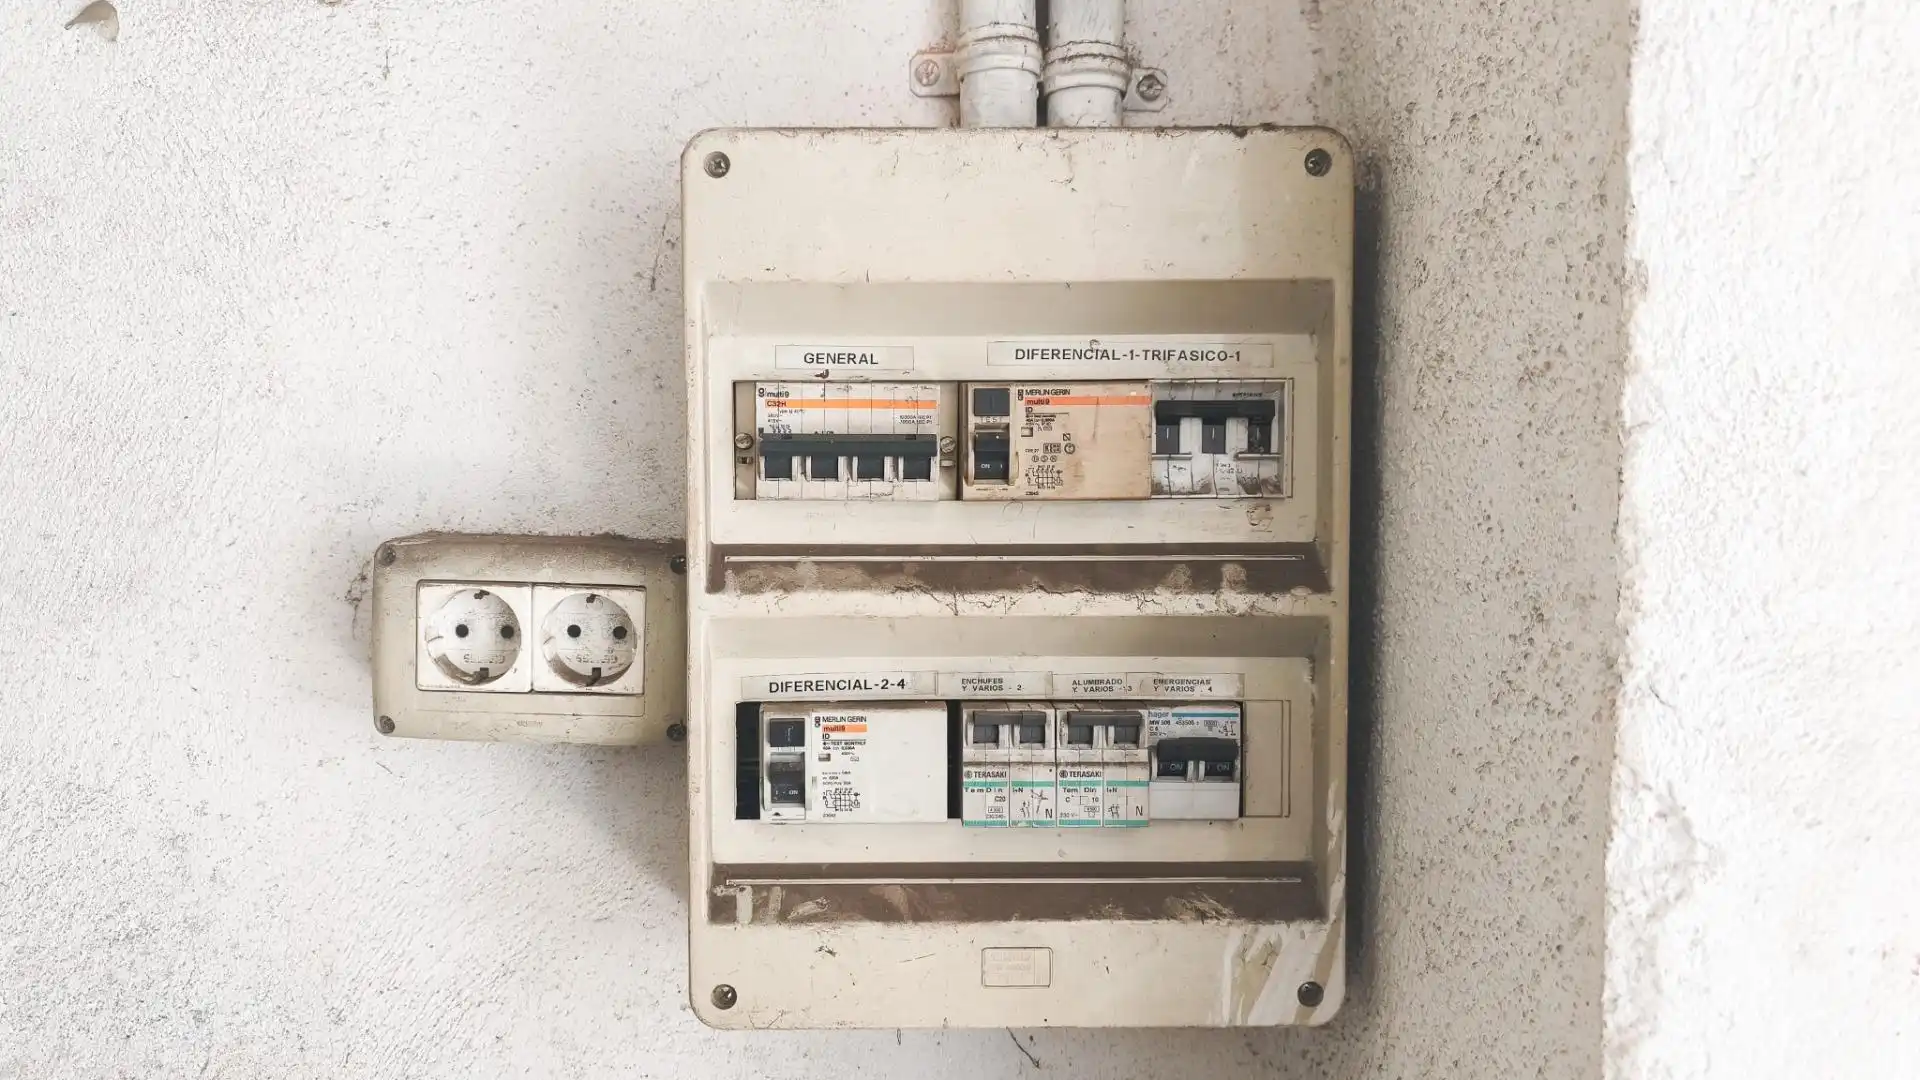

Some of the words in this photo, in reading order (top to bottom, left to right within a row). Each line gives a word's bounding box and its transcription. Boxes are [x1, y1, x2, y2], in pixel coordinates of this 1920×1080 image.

[803, 352, 879, 365] GENERAL
[1014, 347, 1242, 362] DIFERENCIAL-1-TRIFASICO-1
[1025, 388, 1050, 396] MERLIN
[1050, 388, 1071, 396] GERIN
[961, 676, 1004, 685] ENCHUFES
[1071, 678, 1123, 686] ALUMBRADO
[1153, 678, 1212, 686] EMERGENCIAS
[768, 678, 907, 693] DIFERENCIAL-2-4
[961, 684, 968, 692] Y
[972, 684, 1004, 692] VARIOS
[1016, 683, 1022, 692] 2
[1072, 685, 1078, 693] Y
[1083, 685, 1114, 693] VARIOS
[1164, 685, 1196, 693] VARIOS
[1147, 711, 1169, 719] hager
[974, 770, 1007, 778] TERASAKI
[1069, 770, 1102, 778] TERASAKI
[1045, 808, 1053, 819] N
[1135, 805, 1144, 817] N
